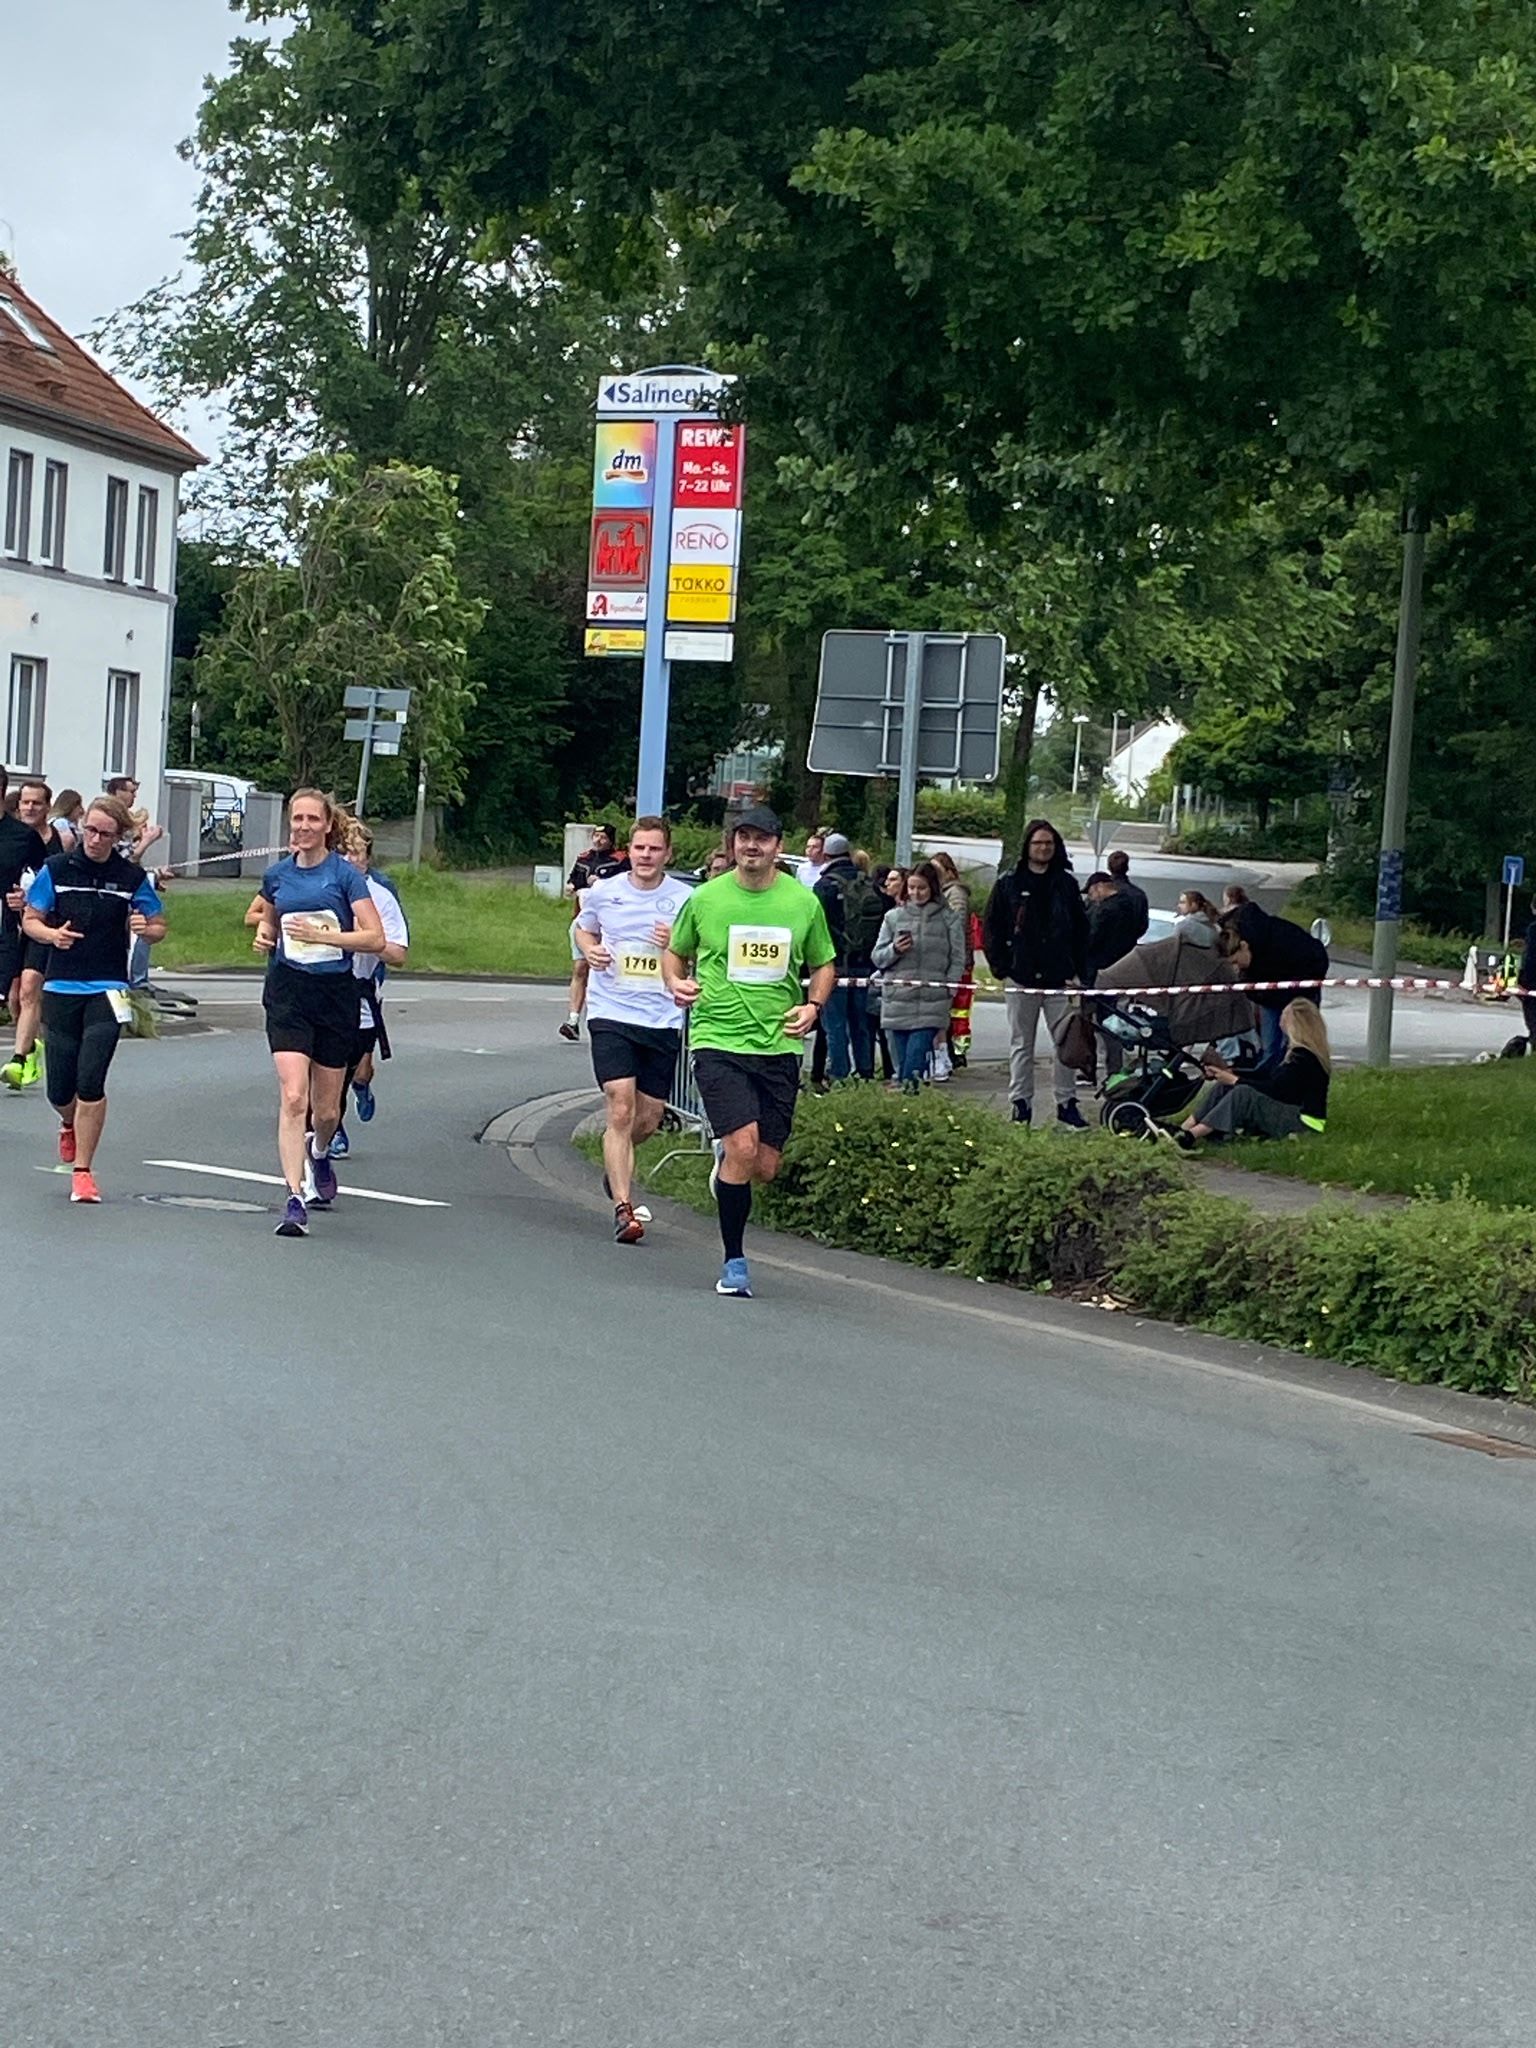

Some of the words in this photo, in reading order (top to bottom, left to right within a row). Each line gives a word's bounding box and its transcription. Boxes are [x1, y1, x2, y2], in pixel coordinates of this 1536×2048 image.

[617, 382, 728, 404] Salinenho
[612, 449, 641, 470] dm
[710, 479, 732, 493] Uhr
[675, 531, 729, 550] RENO
[741, 942, 779, 959] 1359
